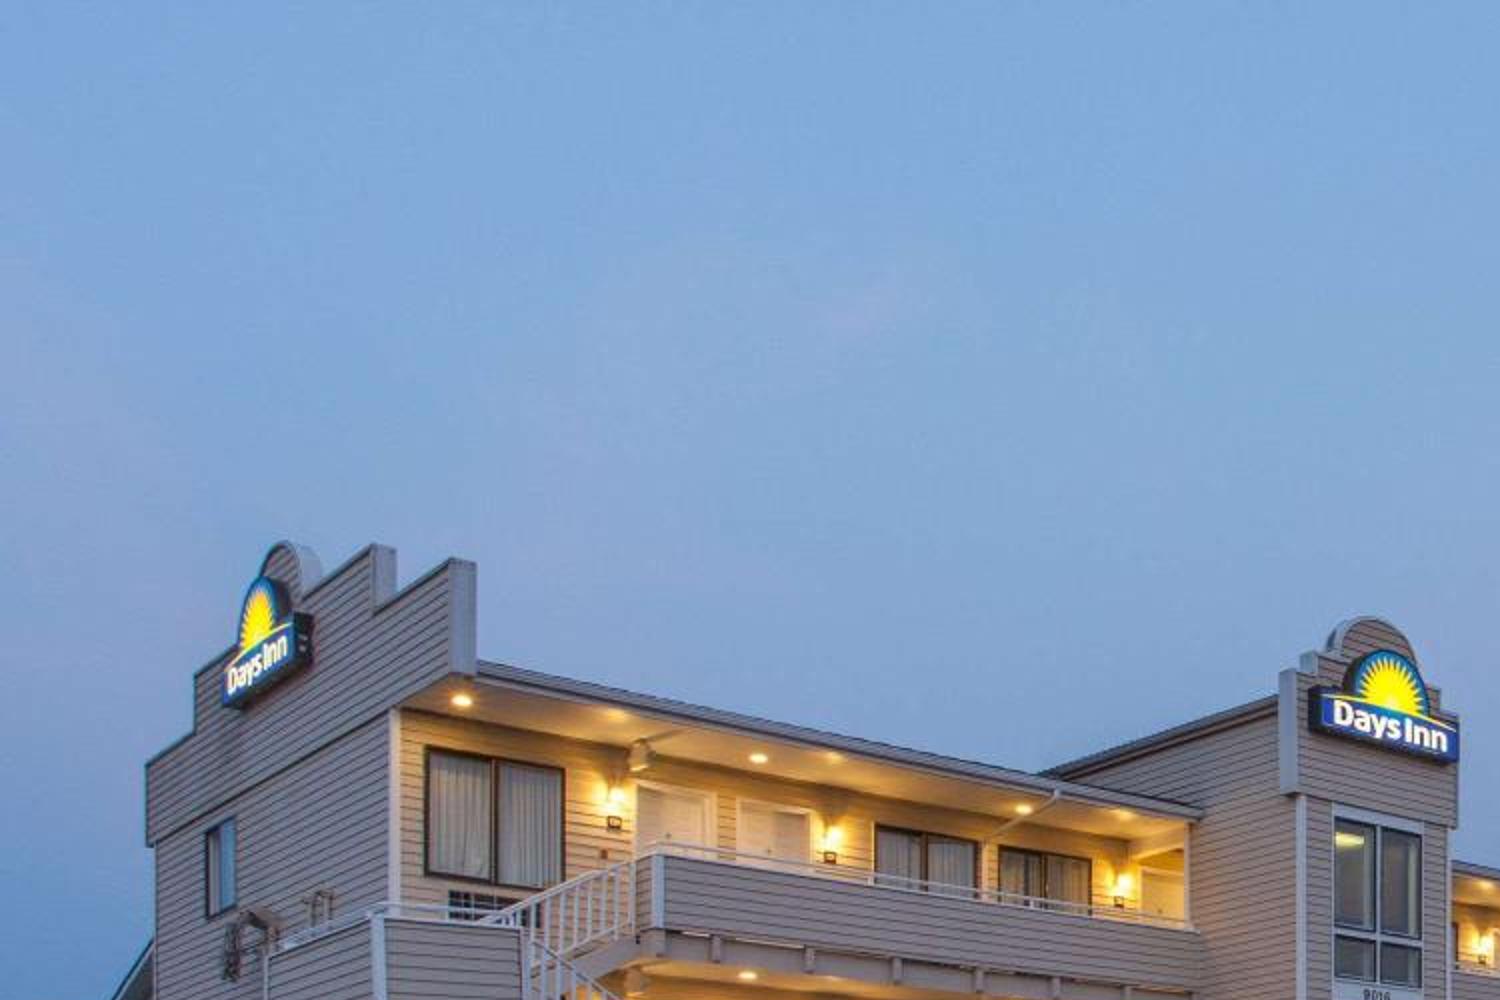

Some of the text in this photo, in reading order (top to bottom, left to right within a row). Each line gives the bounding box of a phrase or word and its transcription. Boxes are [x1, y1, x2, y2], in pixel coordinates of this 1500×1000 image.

[227, 635, 288, 696] Days Inn
[1333, 699, 1448, 753] Days Inn
